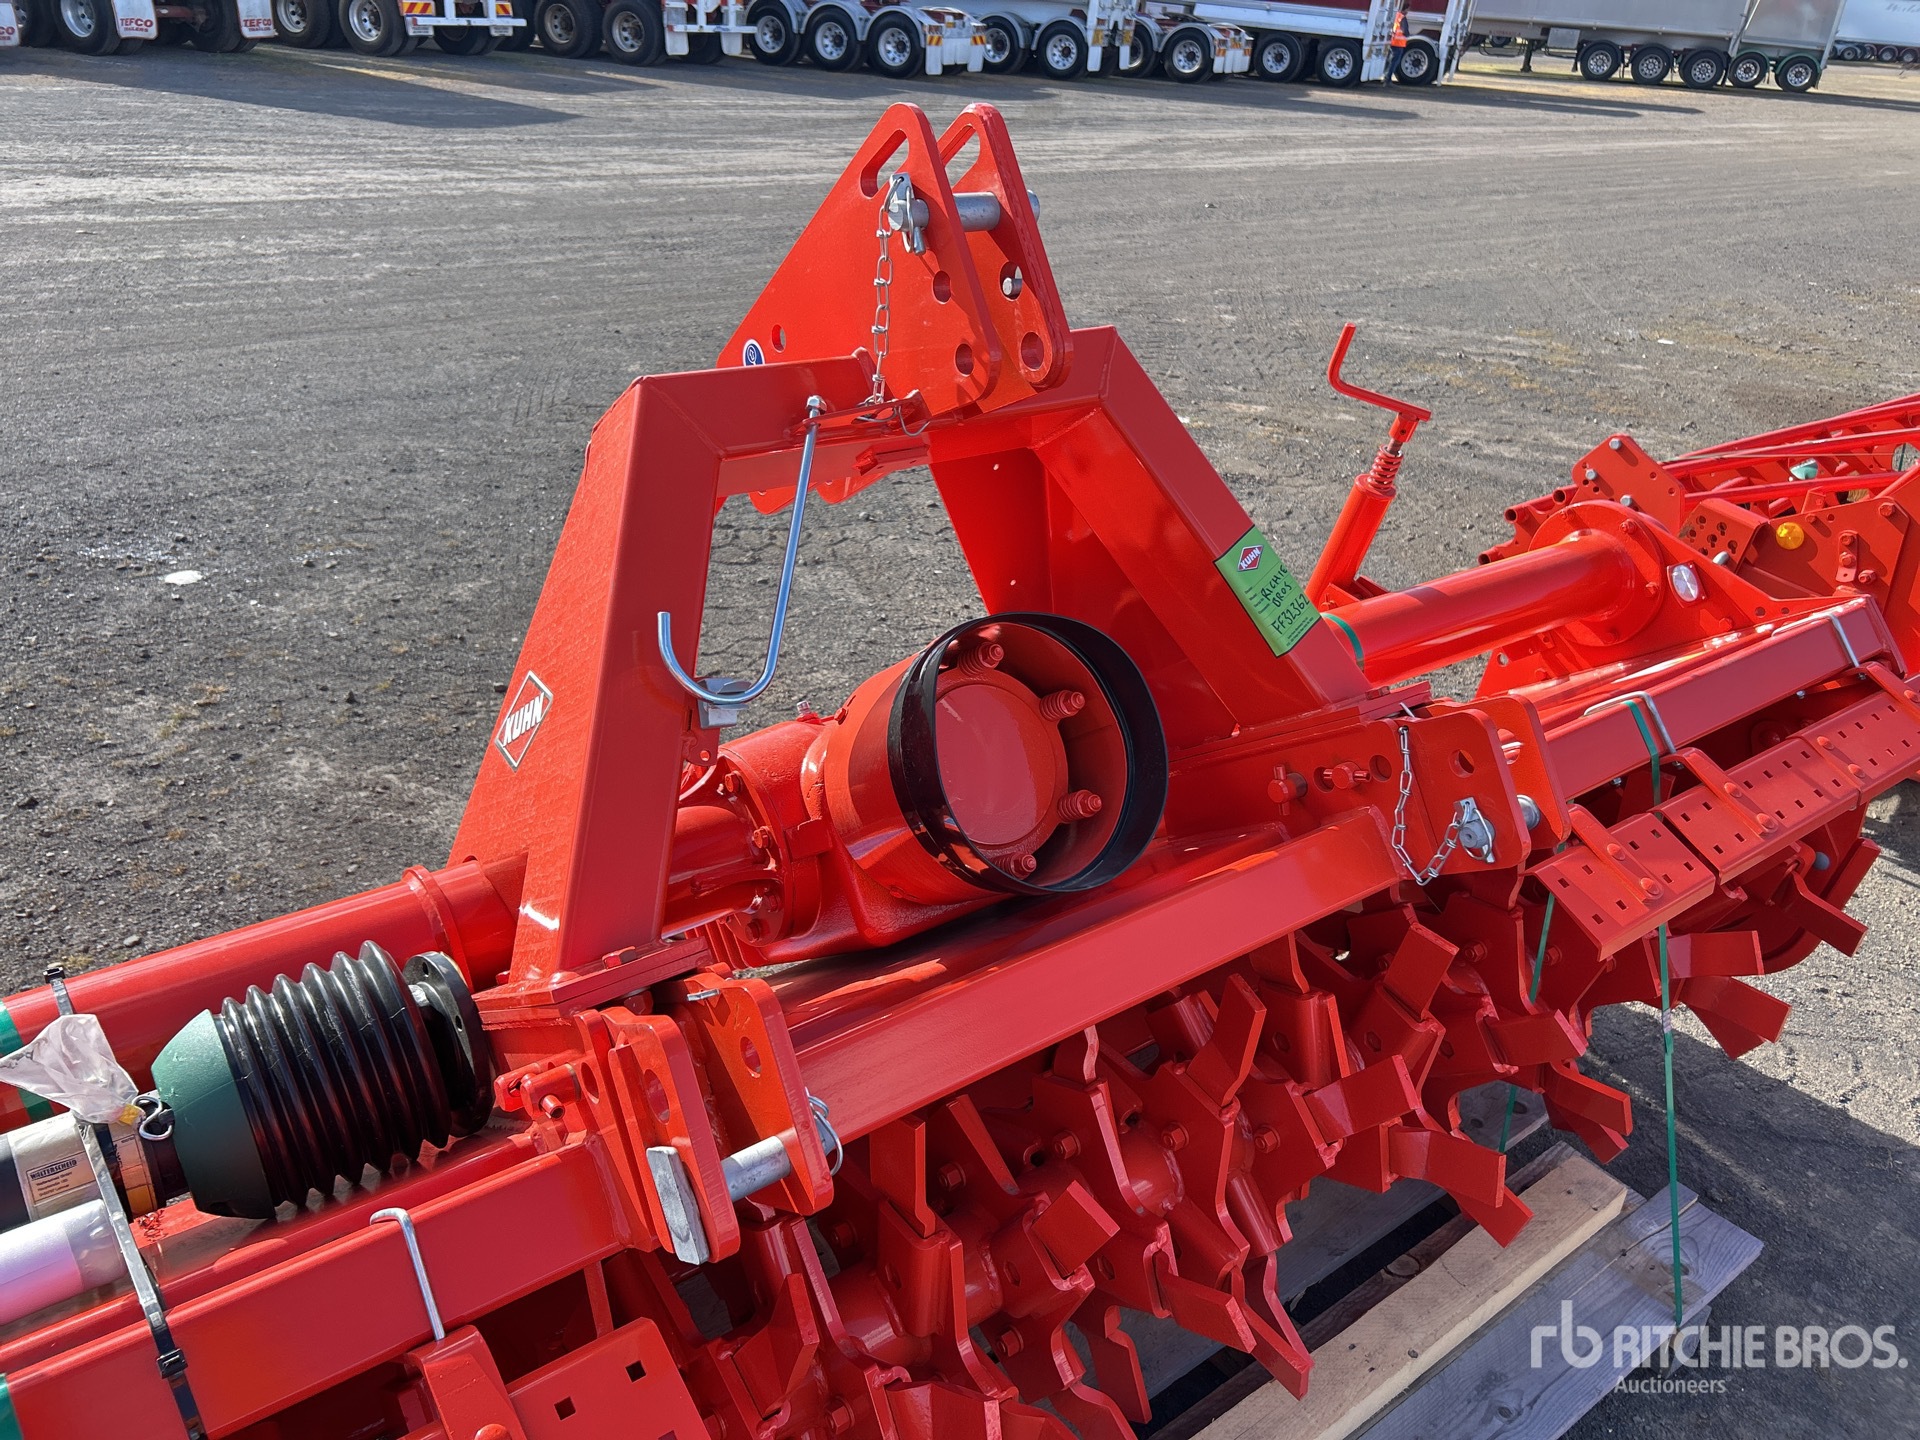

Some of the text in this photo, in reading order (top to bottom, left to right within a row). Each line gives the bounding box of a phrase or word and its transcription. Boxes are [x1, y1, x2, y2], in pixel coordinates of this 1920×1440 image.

[120, 18, 153, 28] TEFCO
[243, 18, 272, 27] TEFCO
[1240, 547, 1263, 570] KUHN
[1260, 564, 1288, 602] RICHIE
[1272, 581, 1293, 608] BROS
[1270, 593, 1310, 635] FF32362
[502, 691, 545, 748] KUHN
